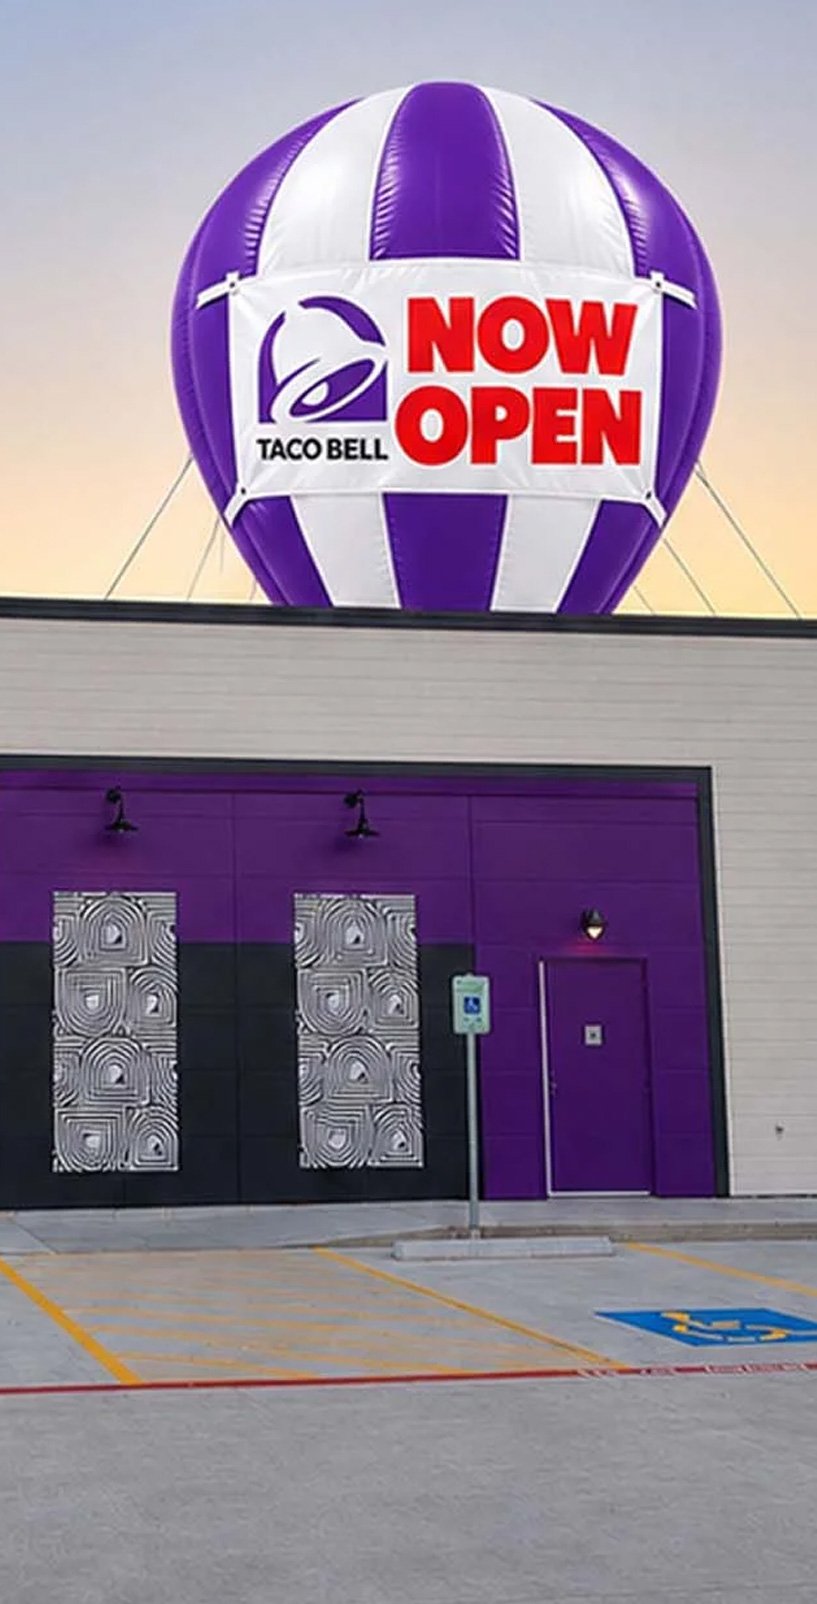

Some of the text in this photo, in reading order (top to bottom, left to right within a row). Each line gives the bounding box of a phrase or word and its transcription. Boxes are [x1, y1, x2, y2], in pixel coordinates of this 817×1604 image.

[408, 297, 637, 375] NOW
[256, 438, 389, 460] TACO BELL
[395, 386, 641, 465] OPEN
